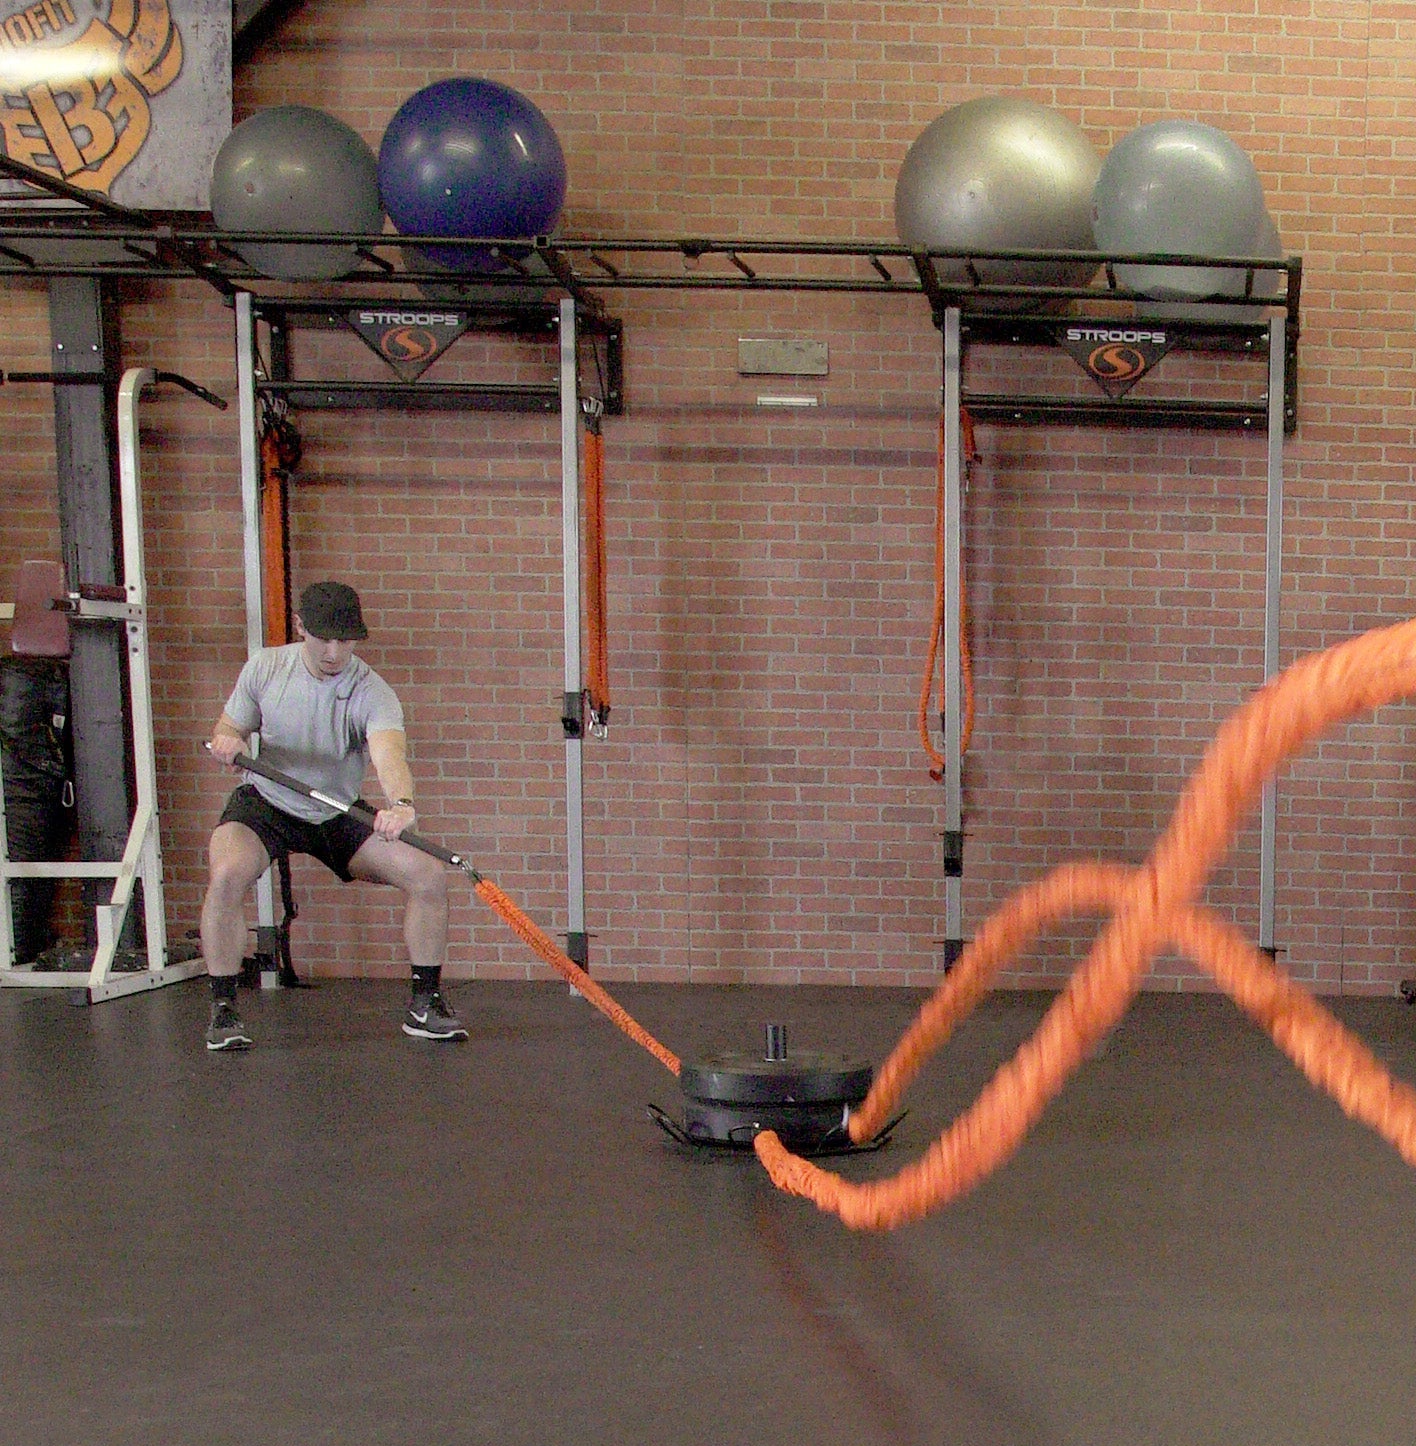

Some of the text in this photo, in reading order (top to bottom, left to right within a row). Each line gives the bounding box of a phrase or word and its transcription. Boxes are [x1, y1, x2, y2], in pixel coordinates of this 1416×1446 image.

[0, 0, 76, 47] OFIT
[359, 312, 459, 326] STROOPS
[1066, 328, 1166, 343] STROOPS
